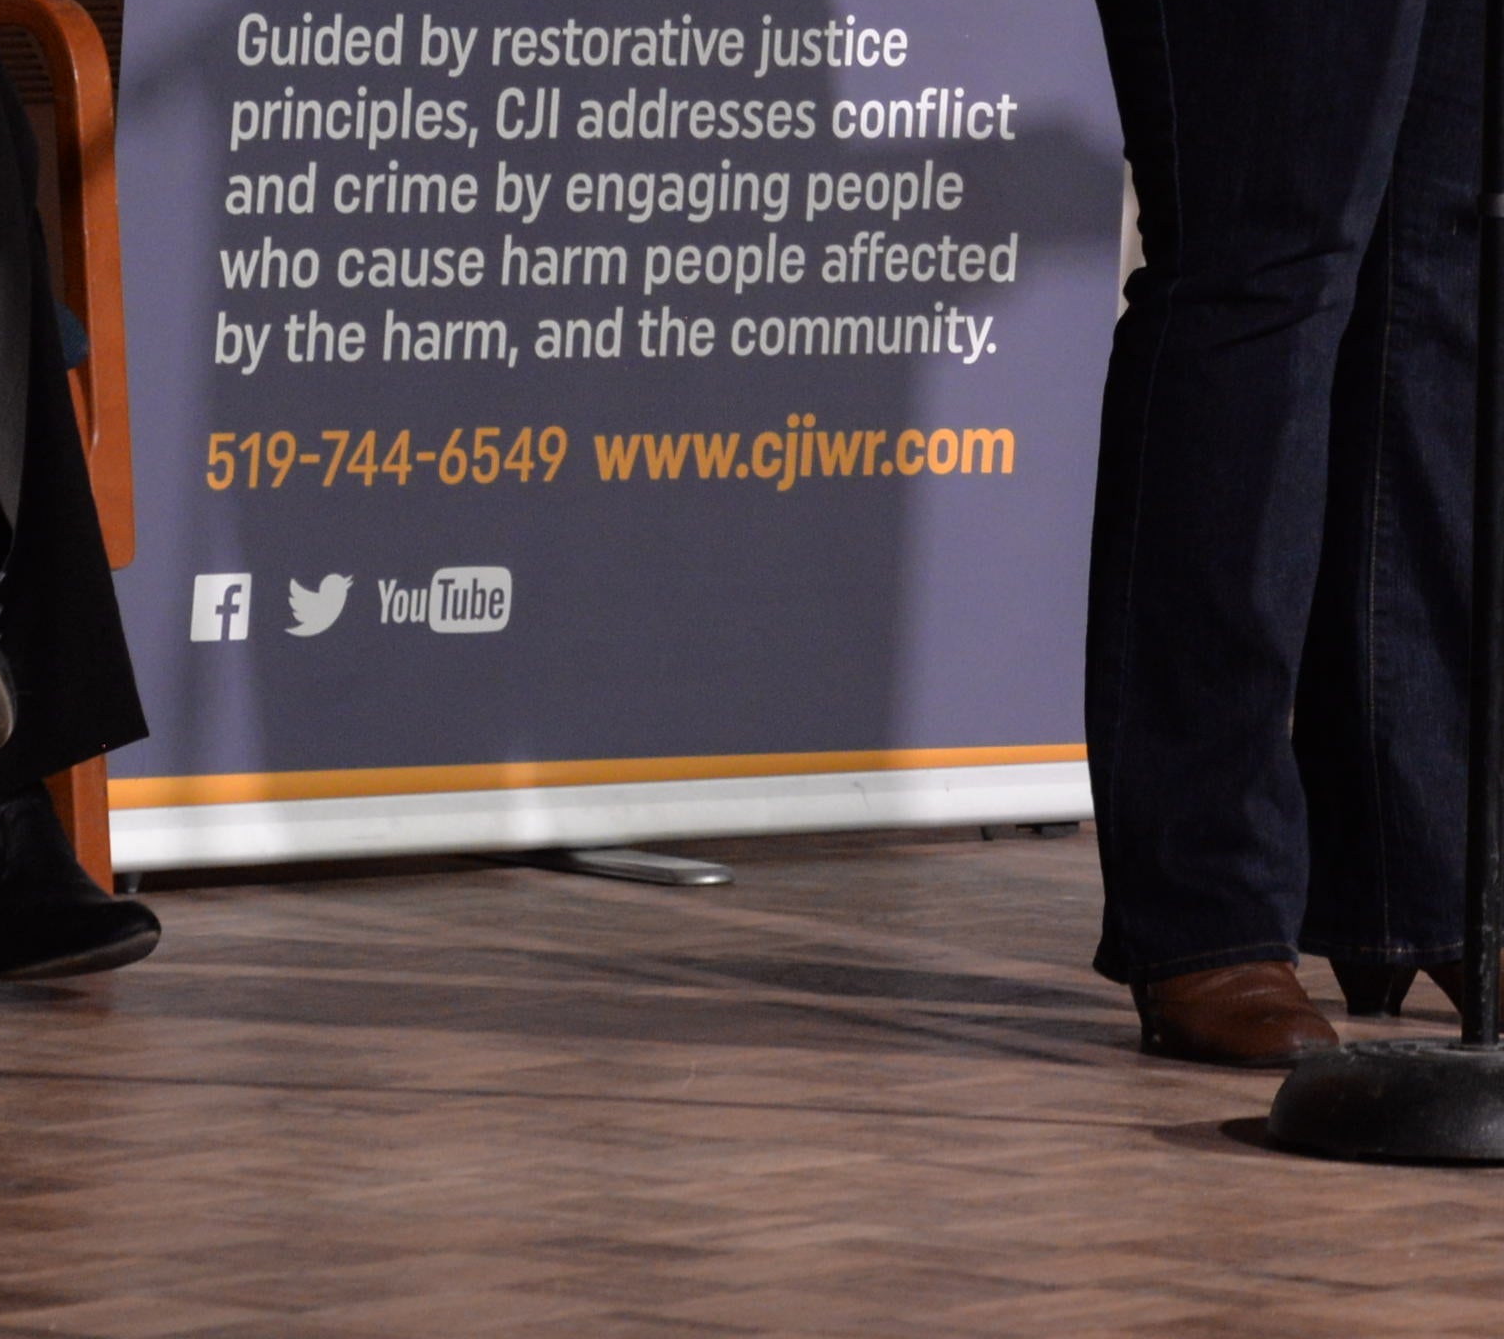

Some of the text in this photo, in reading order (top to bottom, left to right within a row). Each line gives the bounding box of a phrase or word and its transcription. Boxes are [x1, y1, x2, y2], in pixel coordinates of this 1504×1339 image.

[237, 12, 909, 78] Guided by restorative justice
[230, 86, 1018, 152] principles, CJI addresses conflict
[225, 159, 964, 224] and crime by engaging people
[220, 231, 1019, 296] who cause harm people affected
[215, 301, 997, 376] by the harm, and the community.
[206, 413, 1016, 492] 519-744-6549 www.cjiwr.com
[378, 576, 506, 624] YouTube
